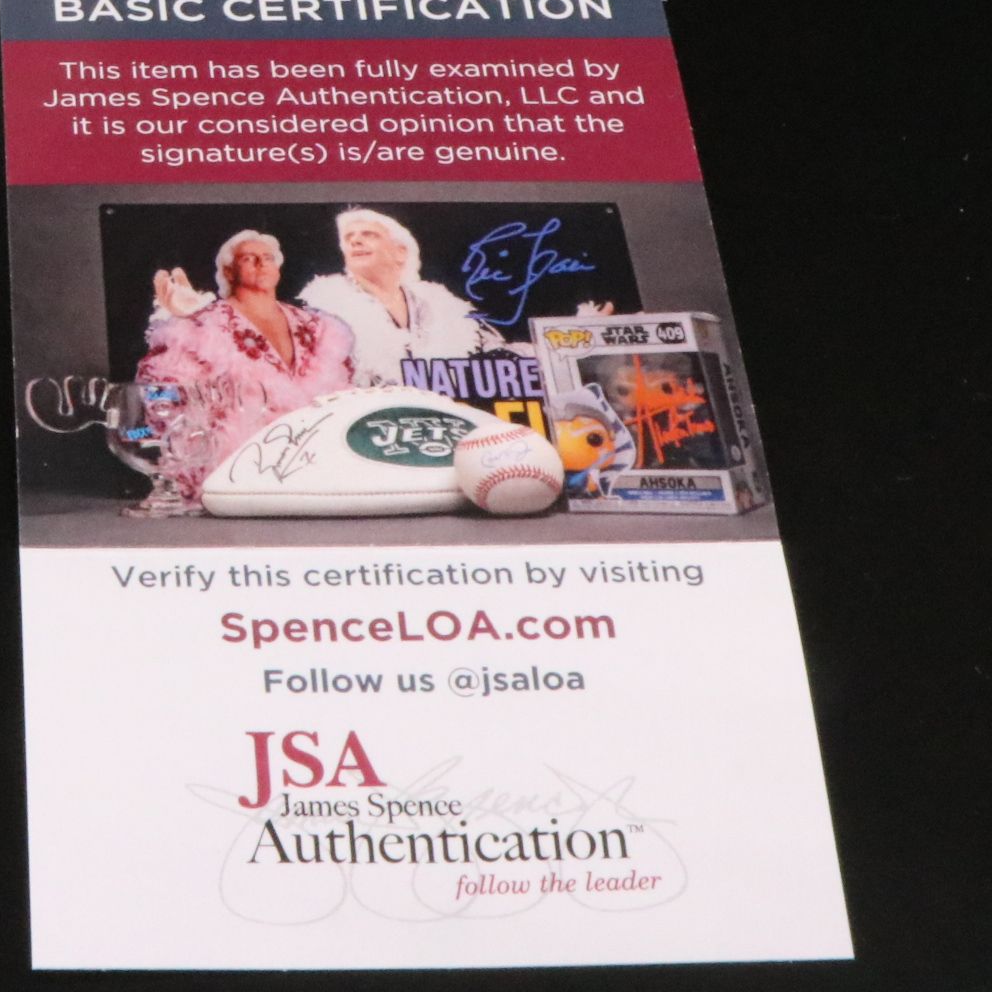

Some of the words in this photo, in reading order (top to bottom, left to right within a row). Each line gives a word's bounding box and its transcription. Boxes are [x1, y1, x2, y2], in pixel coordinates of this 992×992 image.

[59, 60, 121, 80] This
[131, 60, 198, 80] item
[208, 60, 260, 79] has
[270, 59, 346, 79] been
[354, 59, 419, 82] fully
[429, 58, 575, 78] examined
[583, 58, 620, 82] by
[42, 88, 141, 108] James
[151, 87, 265, 112] Spence
[276, 86, 511, 109] Authentication,
[520, 85, 580, 105] LLC
[588, 85, 645, 105] and
[72, 116, 92, 136] it
[103, 116, 126, 135] is
[135, 119, 189, 135] our
[197, 113, 369, 135] considered
[379, 113, 495, 139] opinion
[503, 113, 567, 133] that
[575, 113, 625, 133] the
[140, 142, 328, 167] signature(s)
[338, 141, 425, 165] is/are
[434, 141, 567, 167] genuine.
[601, 325, 649, 336] STAR
[601, 335, 649, 345] WARS
[657, 326, 685, 342] 409
[402, 358, 544, 399] NATURE
[639, 476, 697, 489] AHSOKA
[111, 564, 216, 592] Verify
[228, 564, 291, 588] this
[303, 562, 513, 587] certification
[525, 561, 566, 589] by
[579, 560, 704, 587] visiting
[220, 609, 616, 650] SpenceLOA.com
[263, 667, 383, 694] Follow
[397, 673, 435, 693] us
[447, 665, 585, 698] @jsaloa
[238, 730, 387, 809] JSA
[280, 792, 360, 819] James
[367, 792, 462, 823] Spence
[455, 874, 530, 901] follow
[540, 872, 576, 893] the
[585, 869, 663, 892] leader
